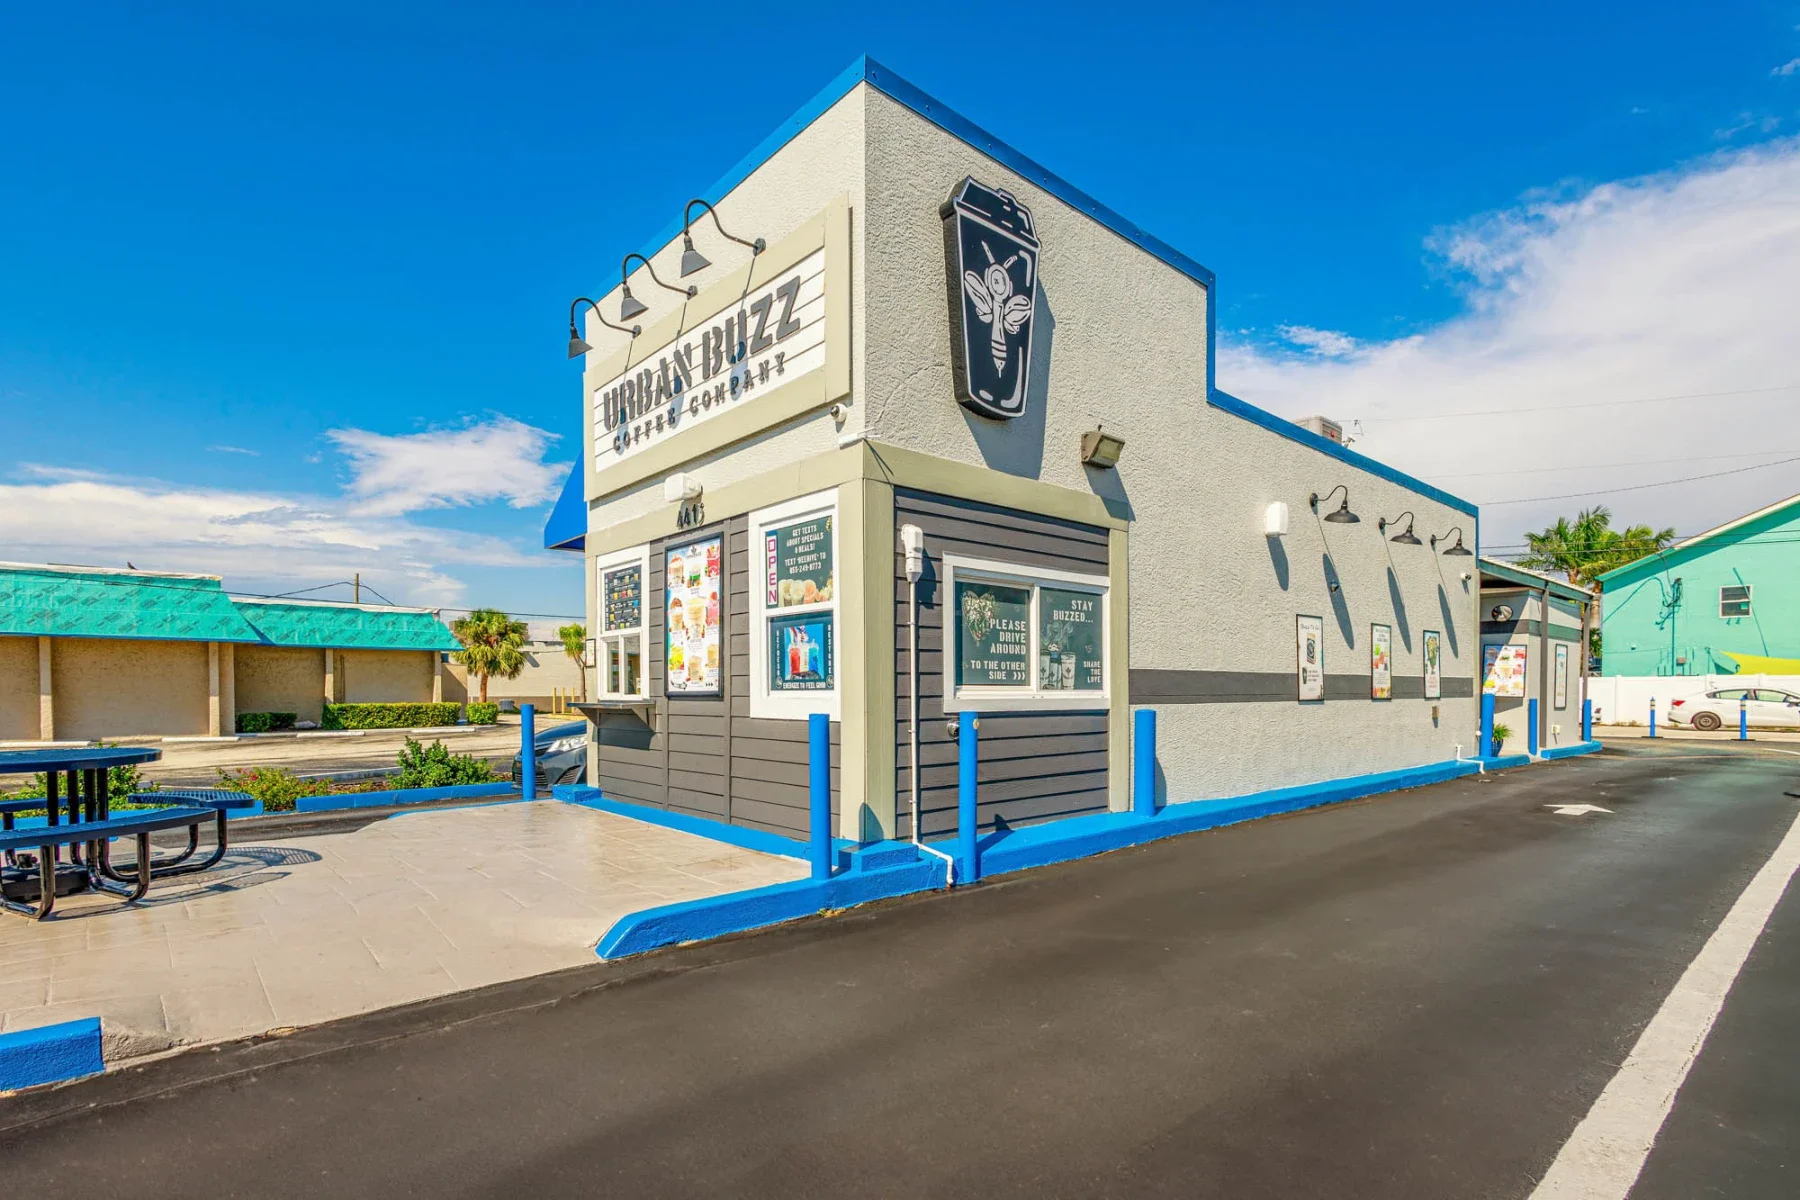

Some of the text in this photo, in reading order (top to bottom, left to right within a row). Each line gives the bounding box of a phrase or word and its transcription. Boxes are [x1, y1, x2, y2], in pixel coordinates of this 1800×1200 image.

[603, 275, 800, 431] URBAN BUZZ
[613, 351, 785, 451] COFFEE COMPANY
[792, 525, 817, 537] GET TEXTS
[786, 532, 824, 547] ABOUT SPECIALS
[784, 557, 796, 566] TEXT
[820, 551, 826, 560] TO
[767, 538, 777, 603] OPEN
[1071, 600, 1093, 611] STAY
[1053, 610, 1094, 623] BUZZED...
[990, 619, 1026, 631] PLEASE
[1000, 631, 1026, 643] DRIVE
[990, 643, 1026, 655] AROUND
[970, 660, 1026, 670] TO THE OTHER
[1083, 660, 1100, 668] SHARE
[989, 671, 1007, 680] SIDE
[1087, 675, 1101, 683] LOVE
